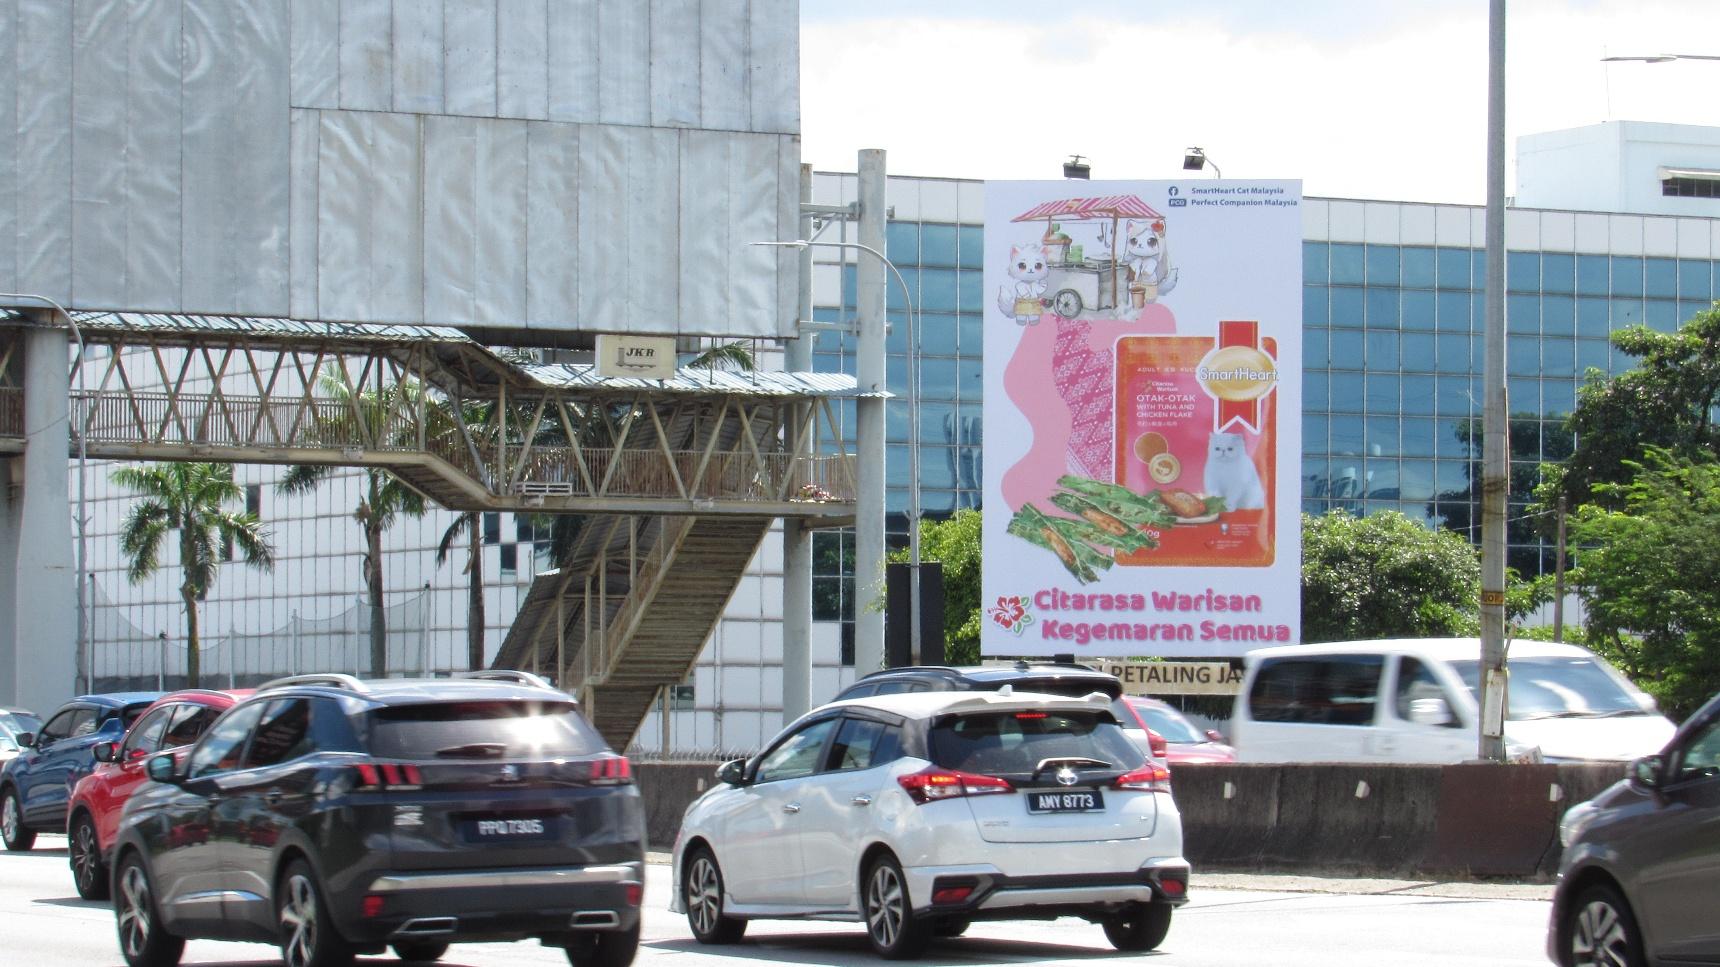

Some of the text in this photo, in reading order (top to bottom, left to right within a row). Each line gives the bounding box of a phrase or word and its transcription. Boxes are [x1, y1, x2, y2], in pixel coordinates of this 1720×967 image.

[1192, 187, 1284, 196] SmartHeart Cat Malaysia
[1220, 199, 1263, 208] Companion
[1265, 199, 1298, 208] Malaysia
[626, 348, 654, 357] JKR
[1200, 368, 1277, 381] SmartHeart
[1136, 394, 1196, 403] OTAK-OTAK
[1034, 588, 1262, 612] Citarasa Warisan
[1041, 619, 1292, 645] Kegemaran Semua
[1111, 666, 1211, 684] PETALING
[1039, 794, 1094, 809] AMY 8773
[508, 819, 544, 834] 7305
